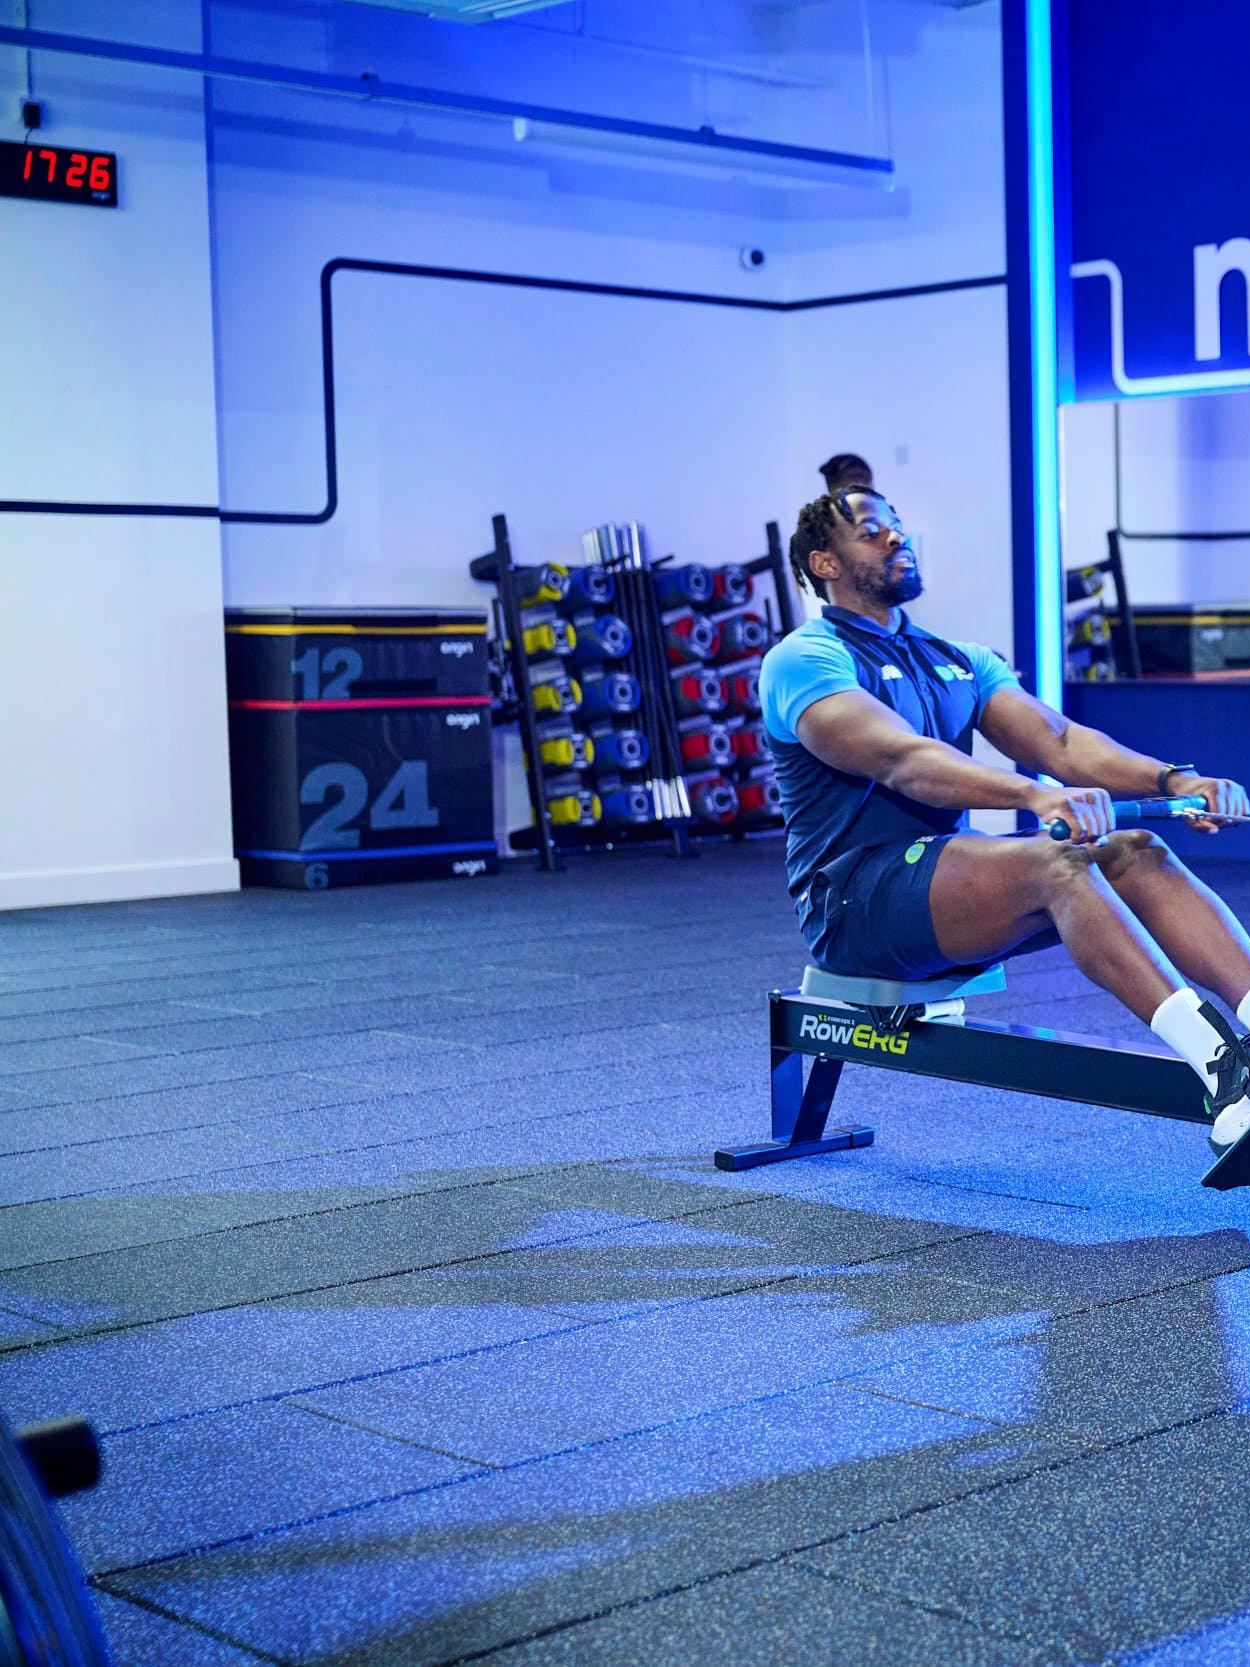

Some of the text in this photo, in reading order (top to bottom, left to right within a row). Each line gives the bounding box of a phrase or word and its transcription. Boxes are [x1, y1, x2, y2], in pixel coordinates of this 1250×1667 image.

[291, 646, 363, 700] 12
[300, 760, 440, 850] 24
[304, 863, 329, 890] 6
